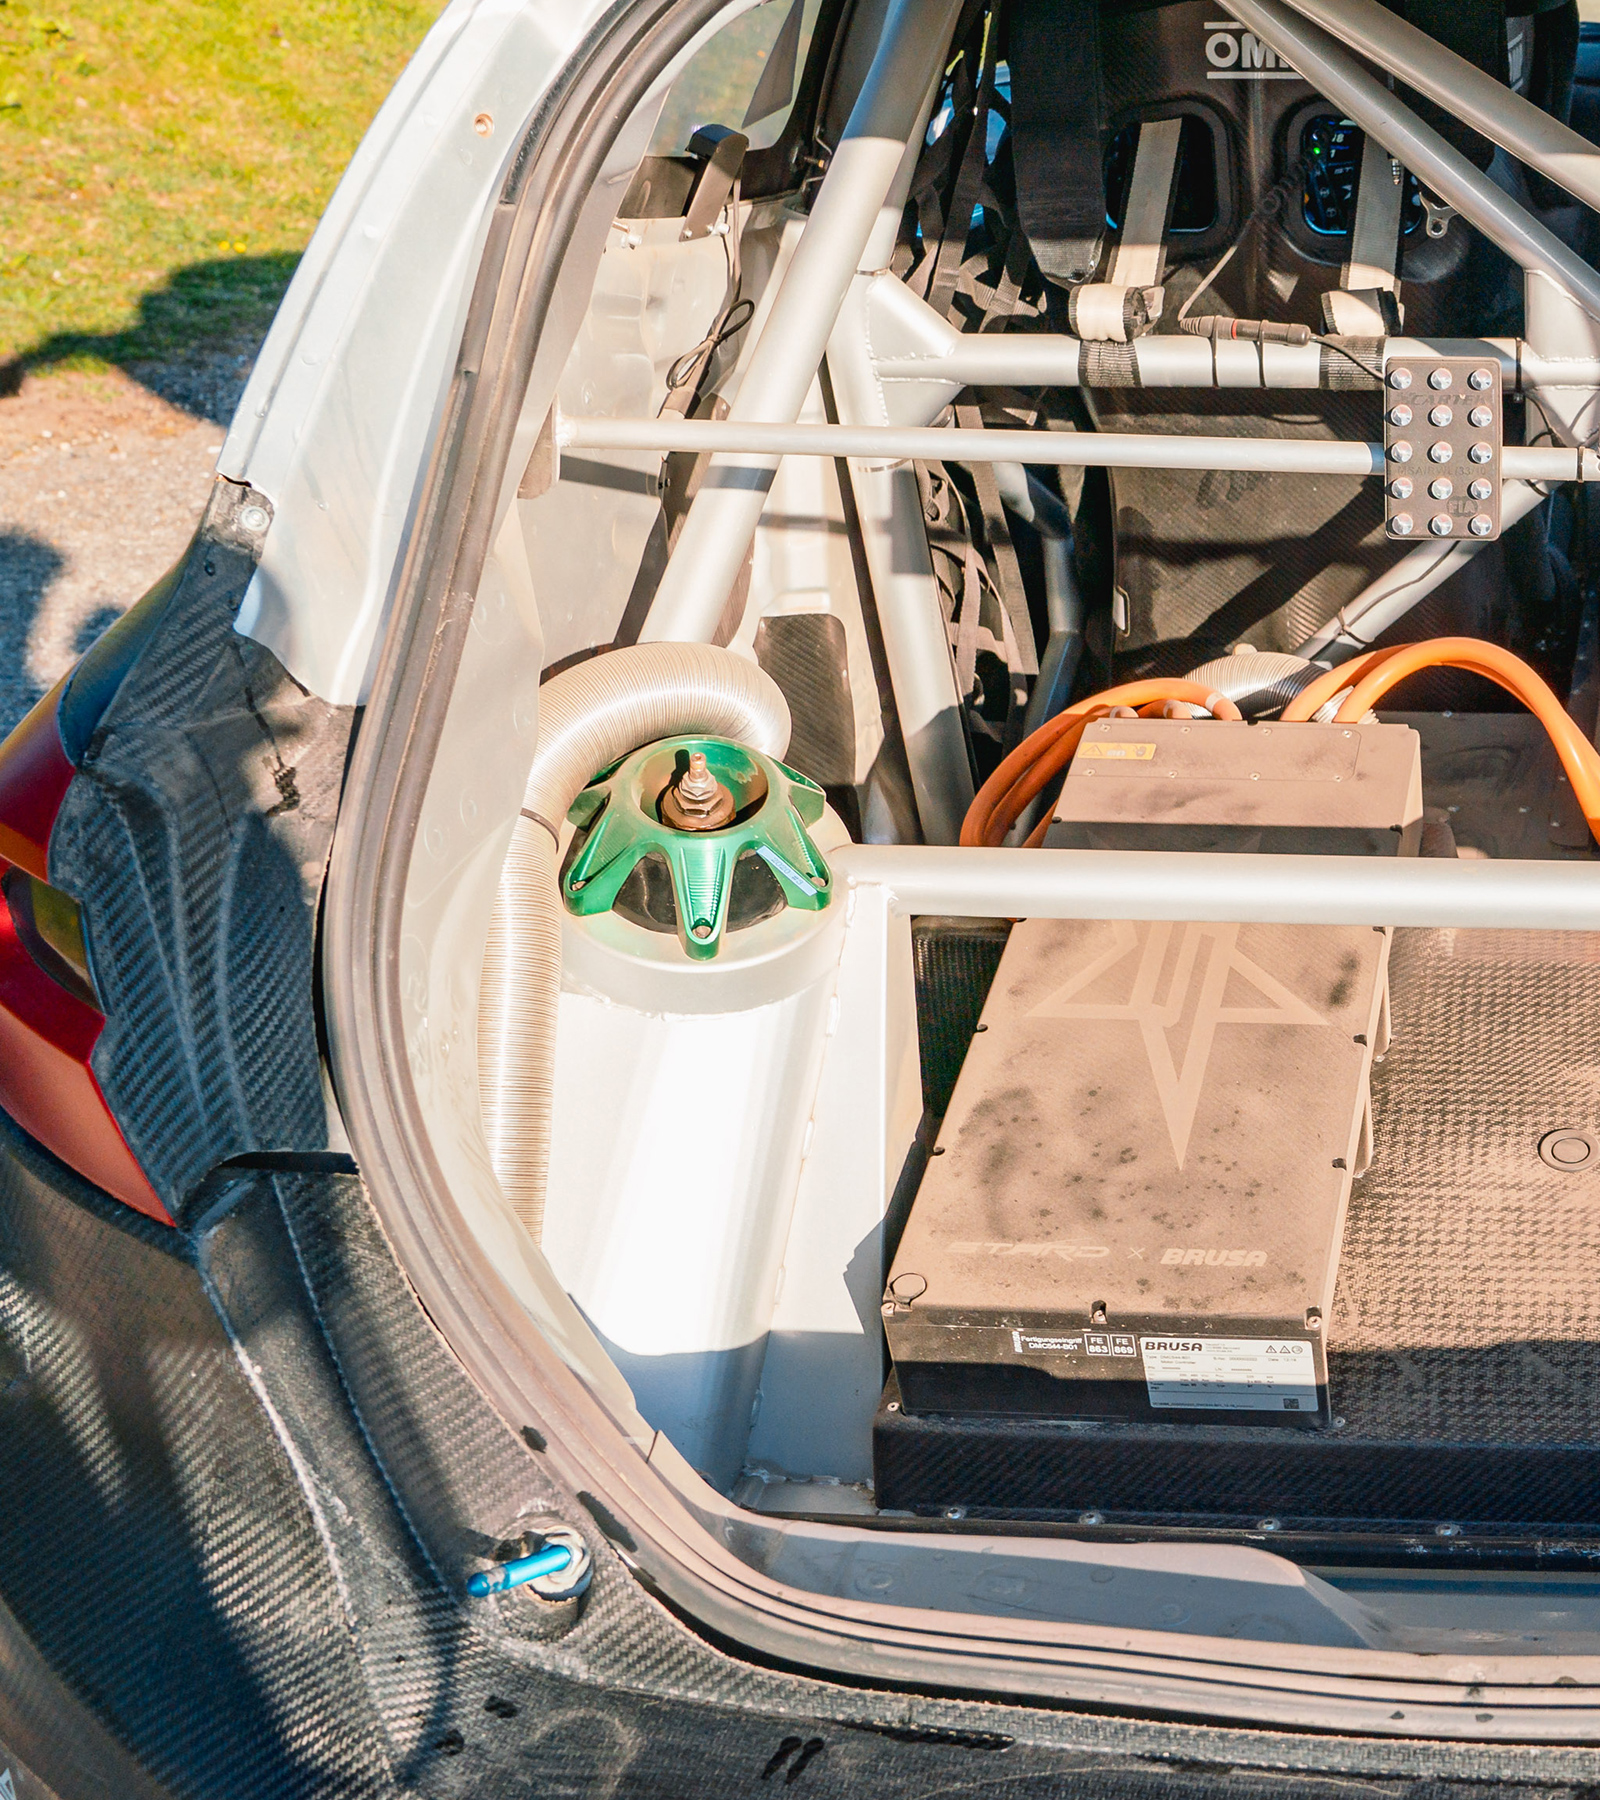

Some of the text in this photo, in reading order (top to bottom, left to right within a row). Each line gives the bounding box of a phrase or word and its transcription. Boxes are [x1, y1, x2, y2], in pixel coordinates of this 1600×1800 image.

[1205, 32, 1289, 68] OM
[1449, 500, 1476, 514] FIA
[945, 1239, 1110, 1262] STARD
[1160, 1248, 1268, 1267] BRUSA
[1021, 1335, 1083, 1344] Fertigungseingriff
[1145, 1341, 1203, 1352] BRUSA
